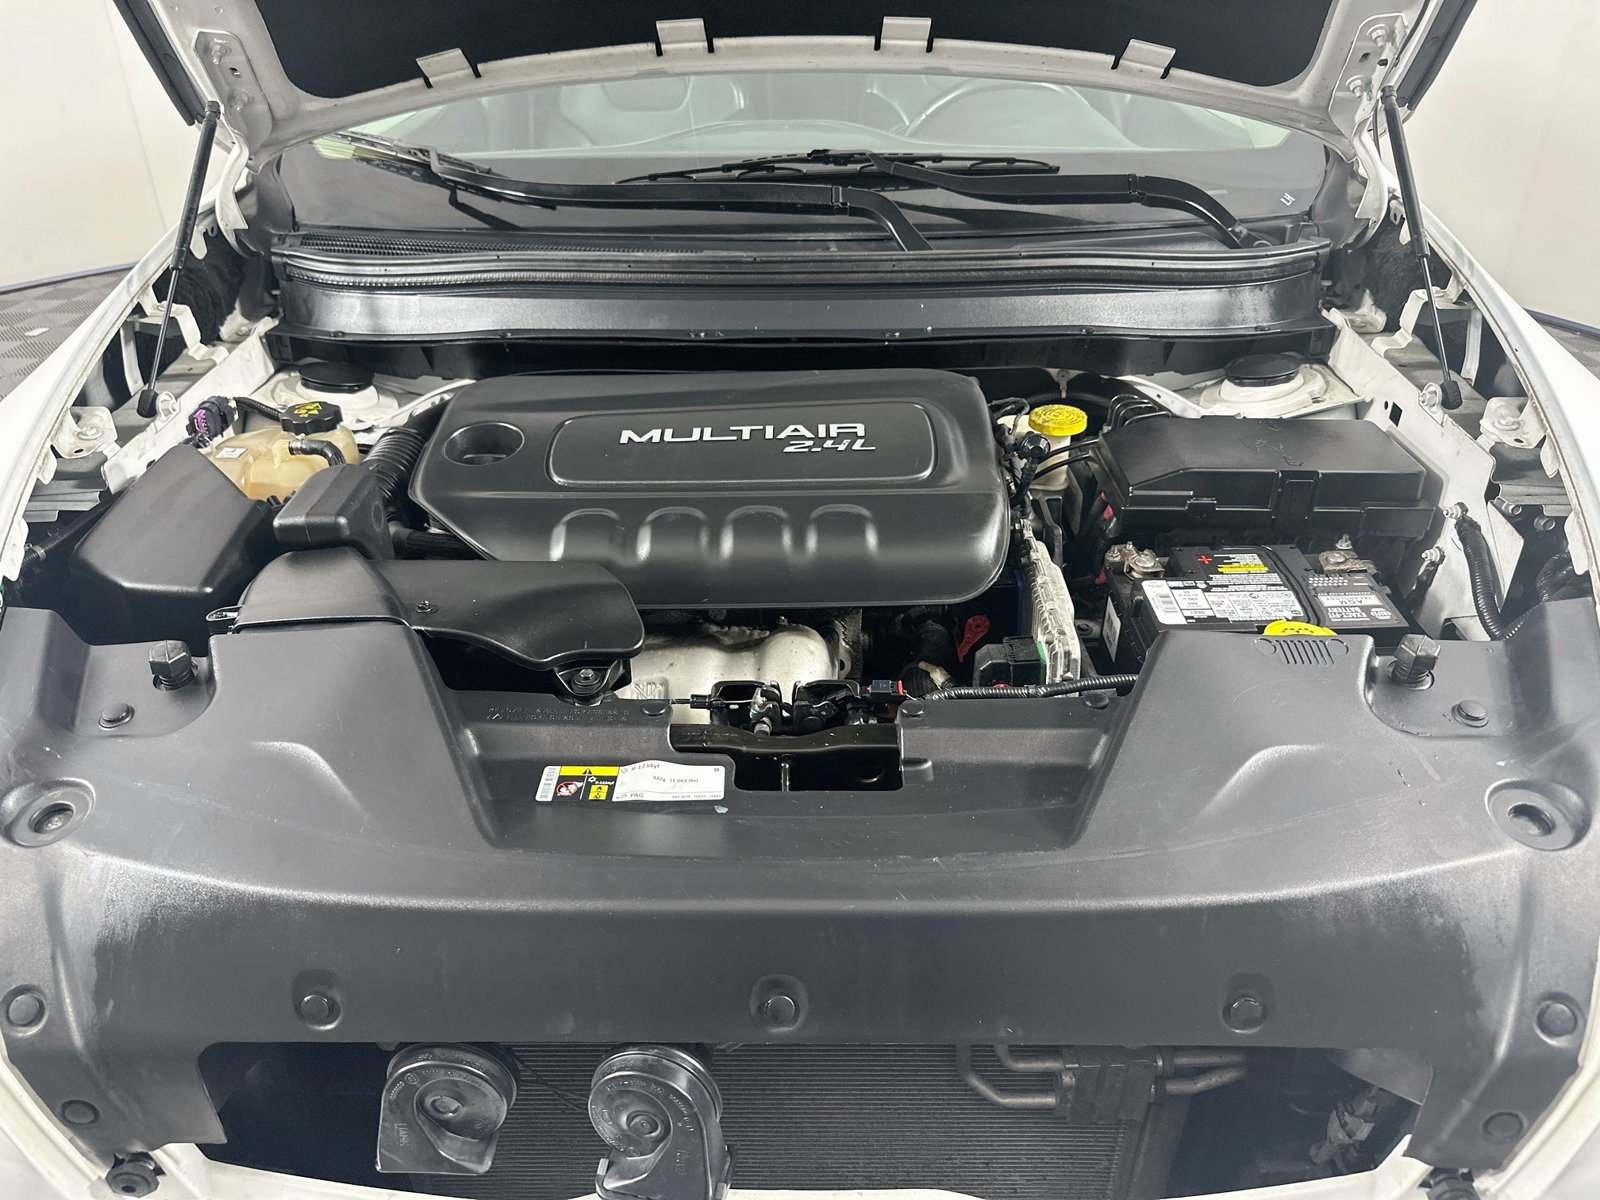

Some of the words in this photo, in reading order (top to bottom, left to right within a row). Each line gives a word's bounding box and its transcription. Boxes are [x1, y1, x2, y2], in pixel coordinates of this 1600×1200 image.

[1279, 192, 1296, 206] LH
[619, 423, 866, 444] MULTIAIR
[783, 439, 876, 453] 2.4L
